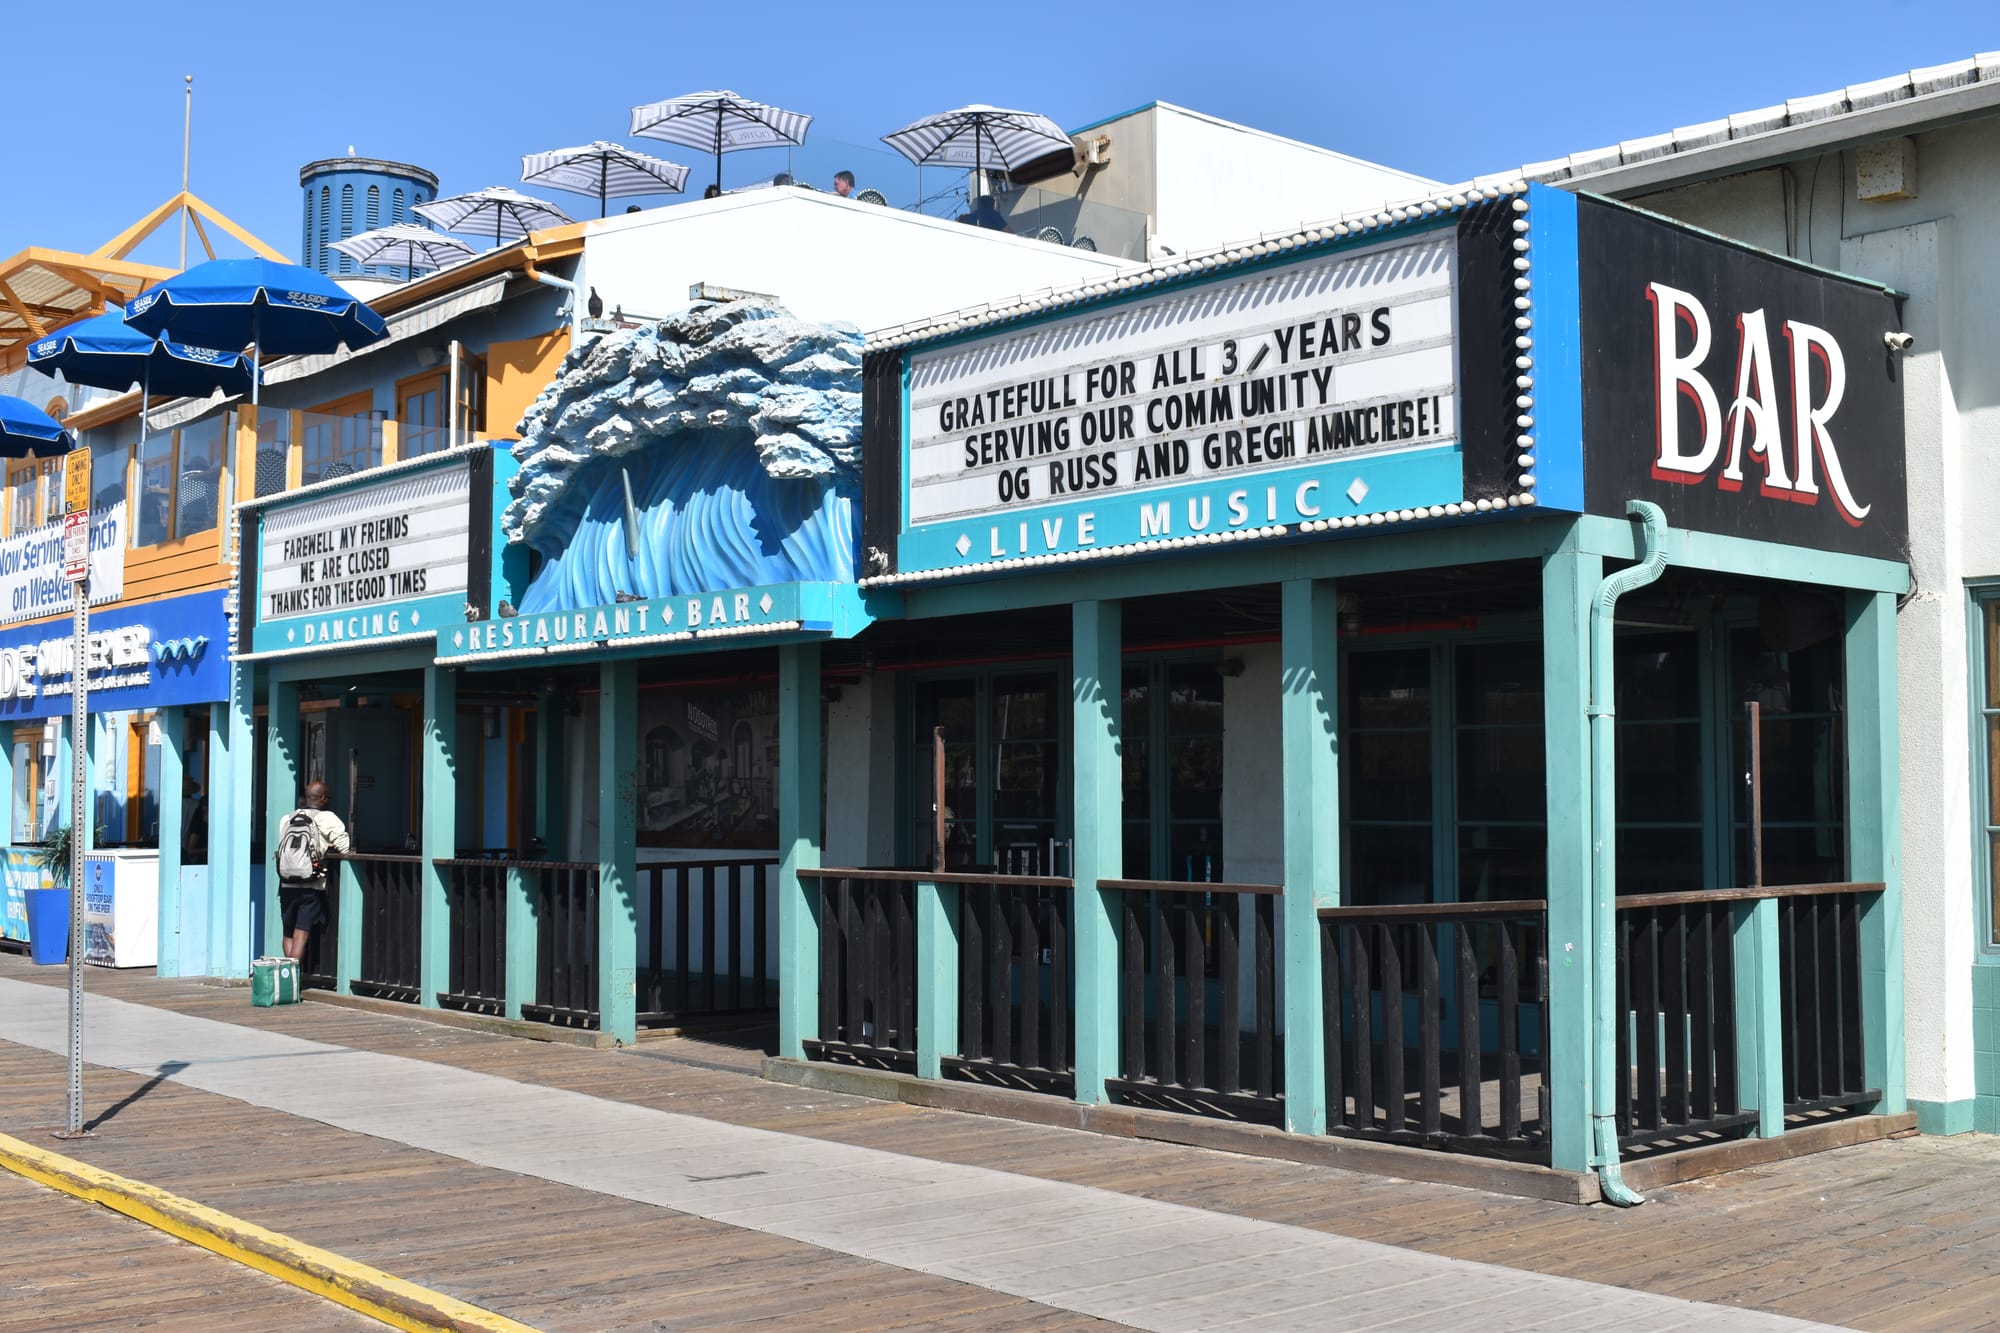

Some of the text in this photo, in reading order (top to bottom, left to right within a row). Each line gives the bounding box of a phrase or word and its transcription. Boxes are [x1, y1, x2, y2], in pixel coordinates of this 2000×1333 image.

[134, 294, 152, 307] SEASIDE
[287, 291, 329, 305] SEASIDE
[38, 340, 57, 353] SEASIDE
[183, 345, 220, 358] SEASIDE
[940, 374, 1076, 432] GRATEFULL
[1087, 361, 1136, 402] FOR
[1152, 346, 1205, 390] ALL
[1274, 307, 1391, 364] YEARS
[965, 365, 1333, 468] SERVING OUR COMMUNITY
[1645, 281, 1871, 528] BAR
[998, 467, 1030, 502] OG
[1050, 451, 1117, 494] RUSS
[1135, 439, 1189, 482] AND
[284, 514, 409, 561] FAREWELL MY FRIENDS
[990, 480, 1320, 557] LIVE MUSIC
[300, 547, 389, 583] WE ARE CLOSED
[13, 584, 27, 612] on
[271, 568, 427, 614] THANKS FOR THE GOOD TIMES
[305, 610, 399, 644] DANCING
[469, 593, 750, 650] RESTAURANT BAR
